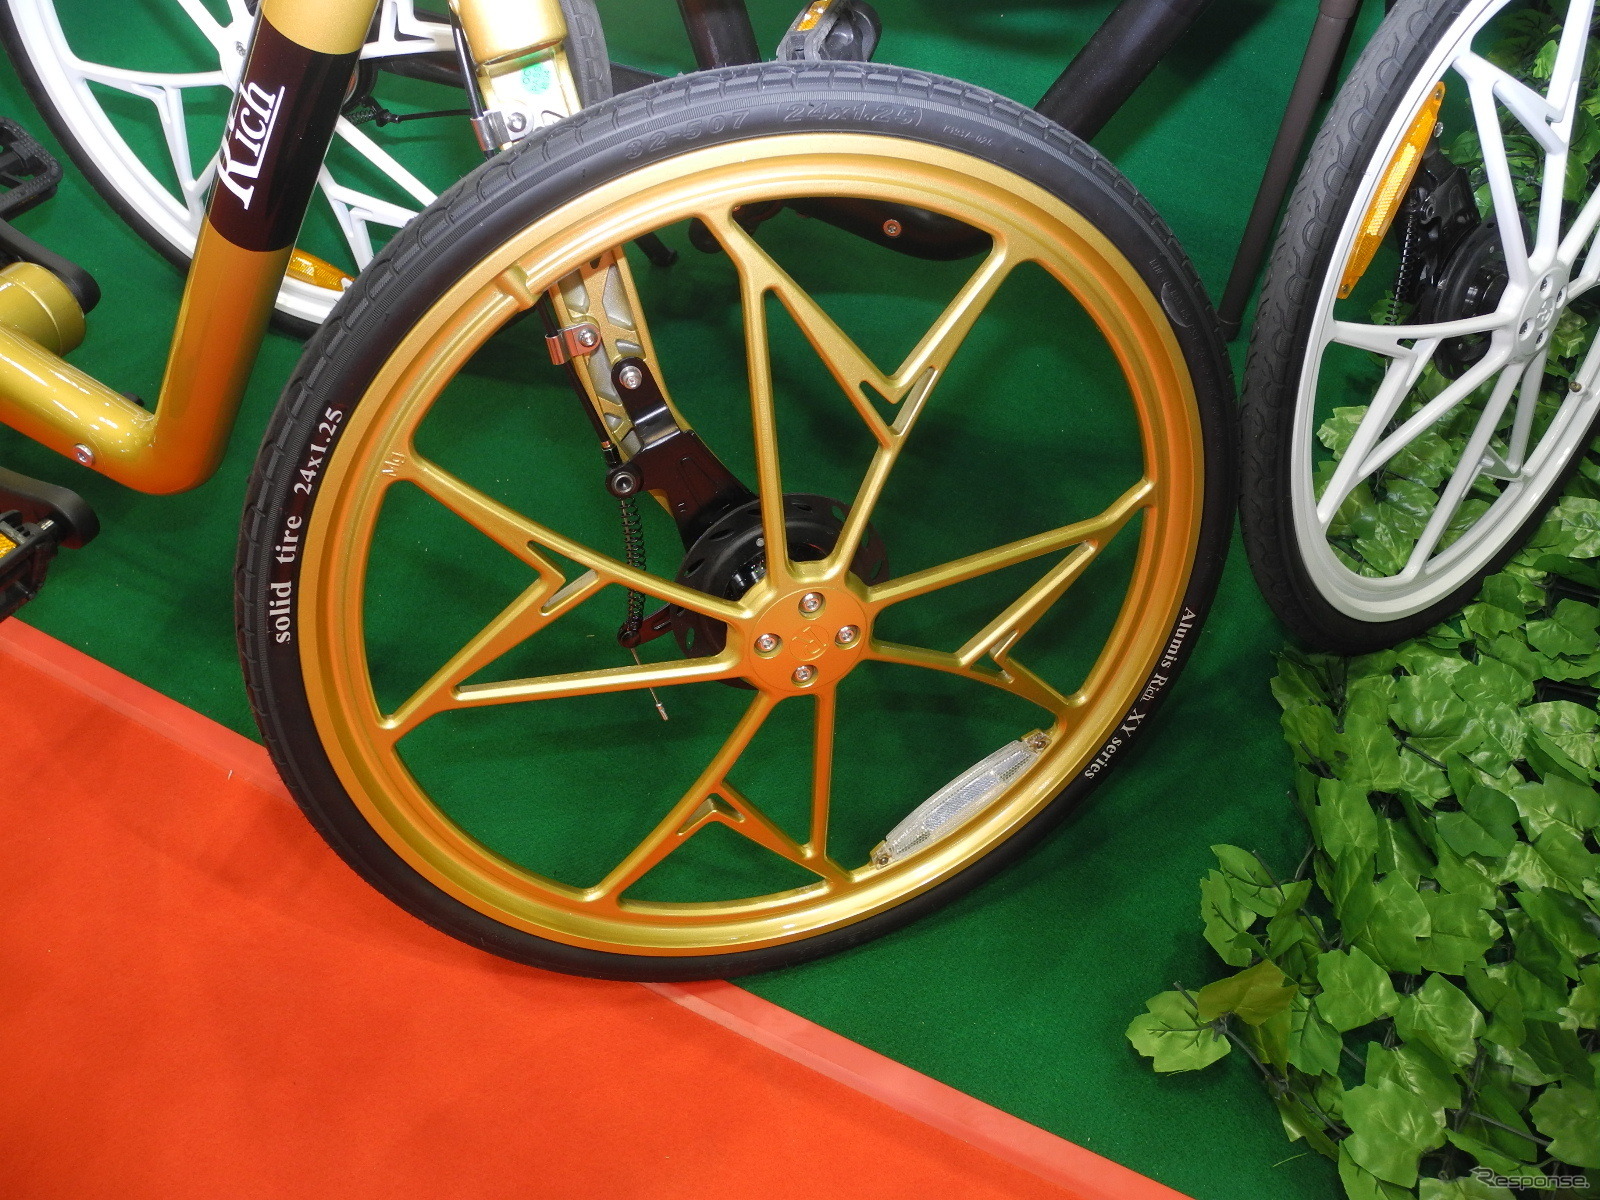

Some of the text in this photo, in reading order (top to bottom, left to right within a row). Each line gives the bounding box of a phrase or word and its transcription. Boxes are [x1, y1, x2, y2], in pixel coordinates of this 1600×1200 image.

[624, 109, 750, 160] 32-507
[269, 406, 344, 645] solid tire 24x1.25
[1160, 606, 1197, 669] Alumis
[1120, 707, 1147, 738] XY
[1084, 736, 1123, 779] series
